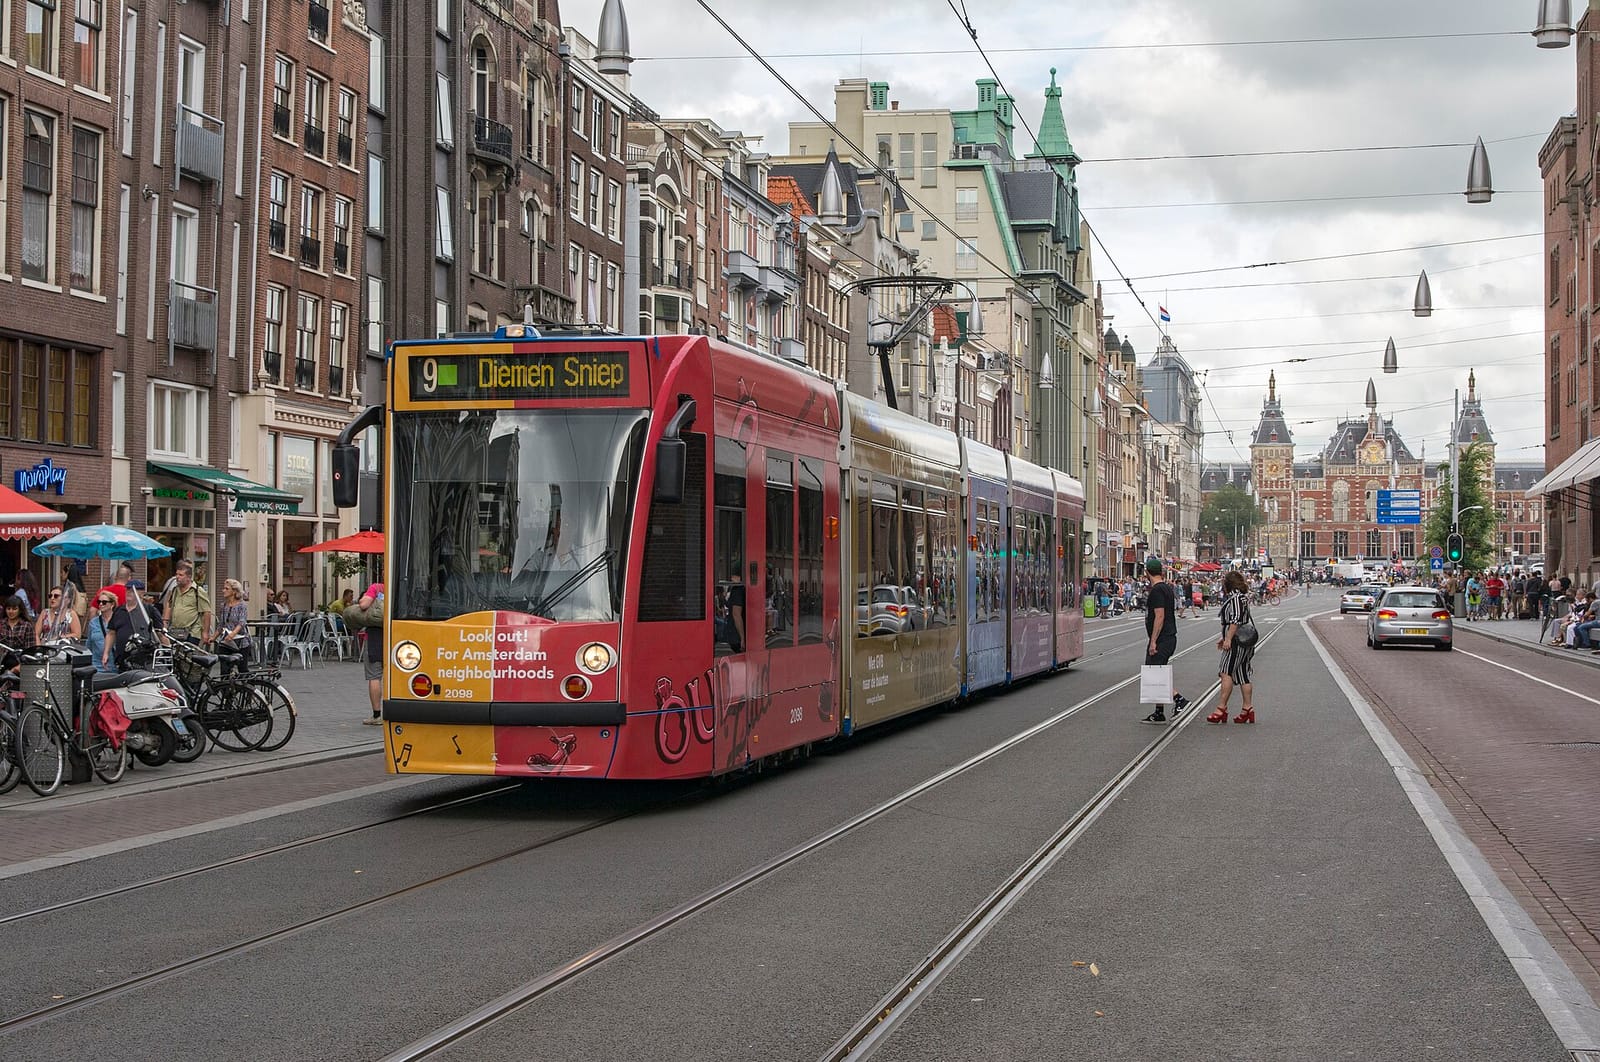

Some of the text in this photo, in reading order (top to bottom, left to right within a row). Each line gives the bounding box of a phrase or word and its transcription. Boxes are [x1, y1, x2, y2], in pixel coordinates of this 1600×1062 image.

[423, 356, 624, 393] 9 Diemen Sniep
[247, 501, 290, 511] NEW YORK PIZZA
[459, 629, 528, 644] Look out!
[438, 648, 547, 661] For Amsterdam
[438, 667, 554, 681] neighbourhoods
[444, 688, 473, 699] 2098
[790, 706, 803, 724] 2098
